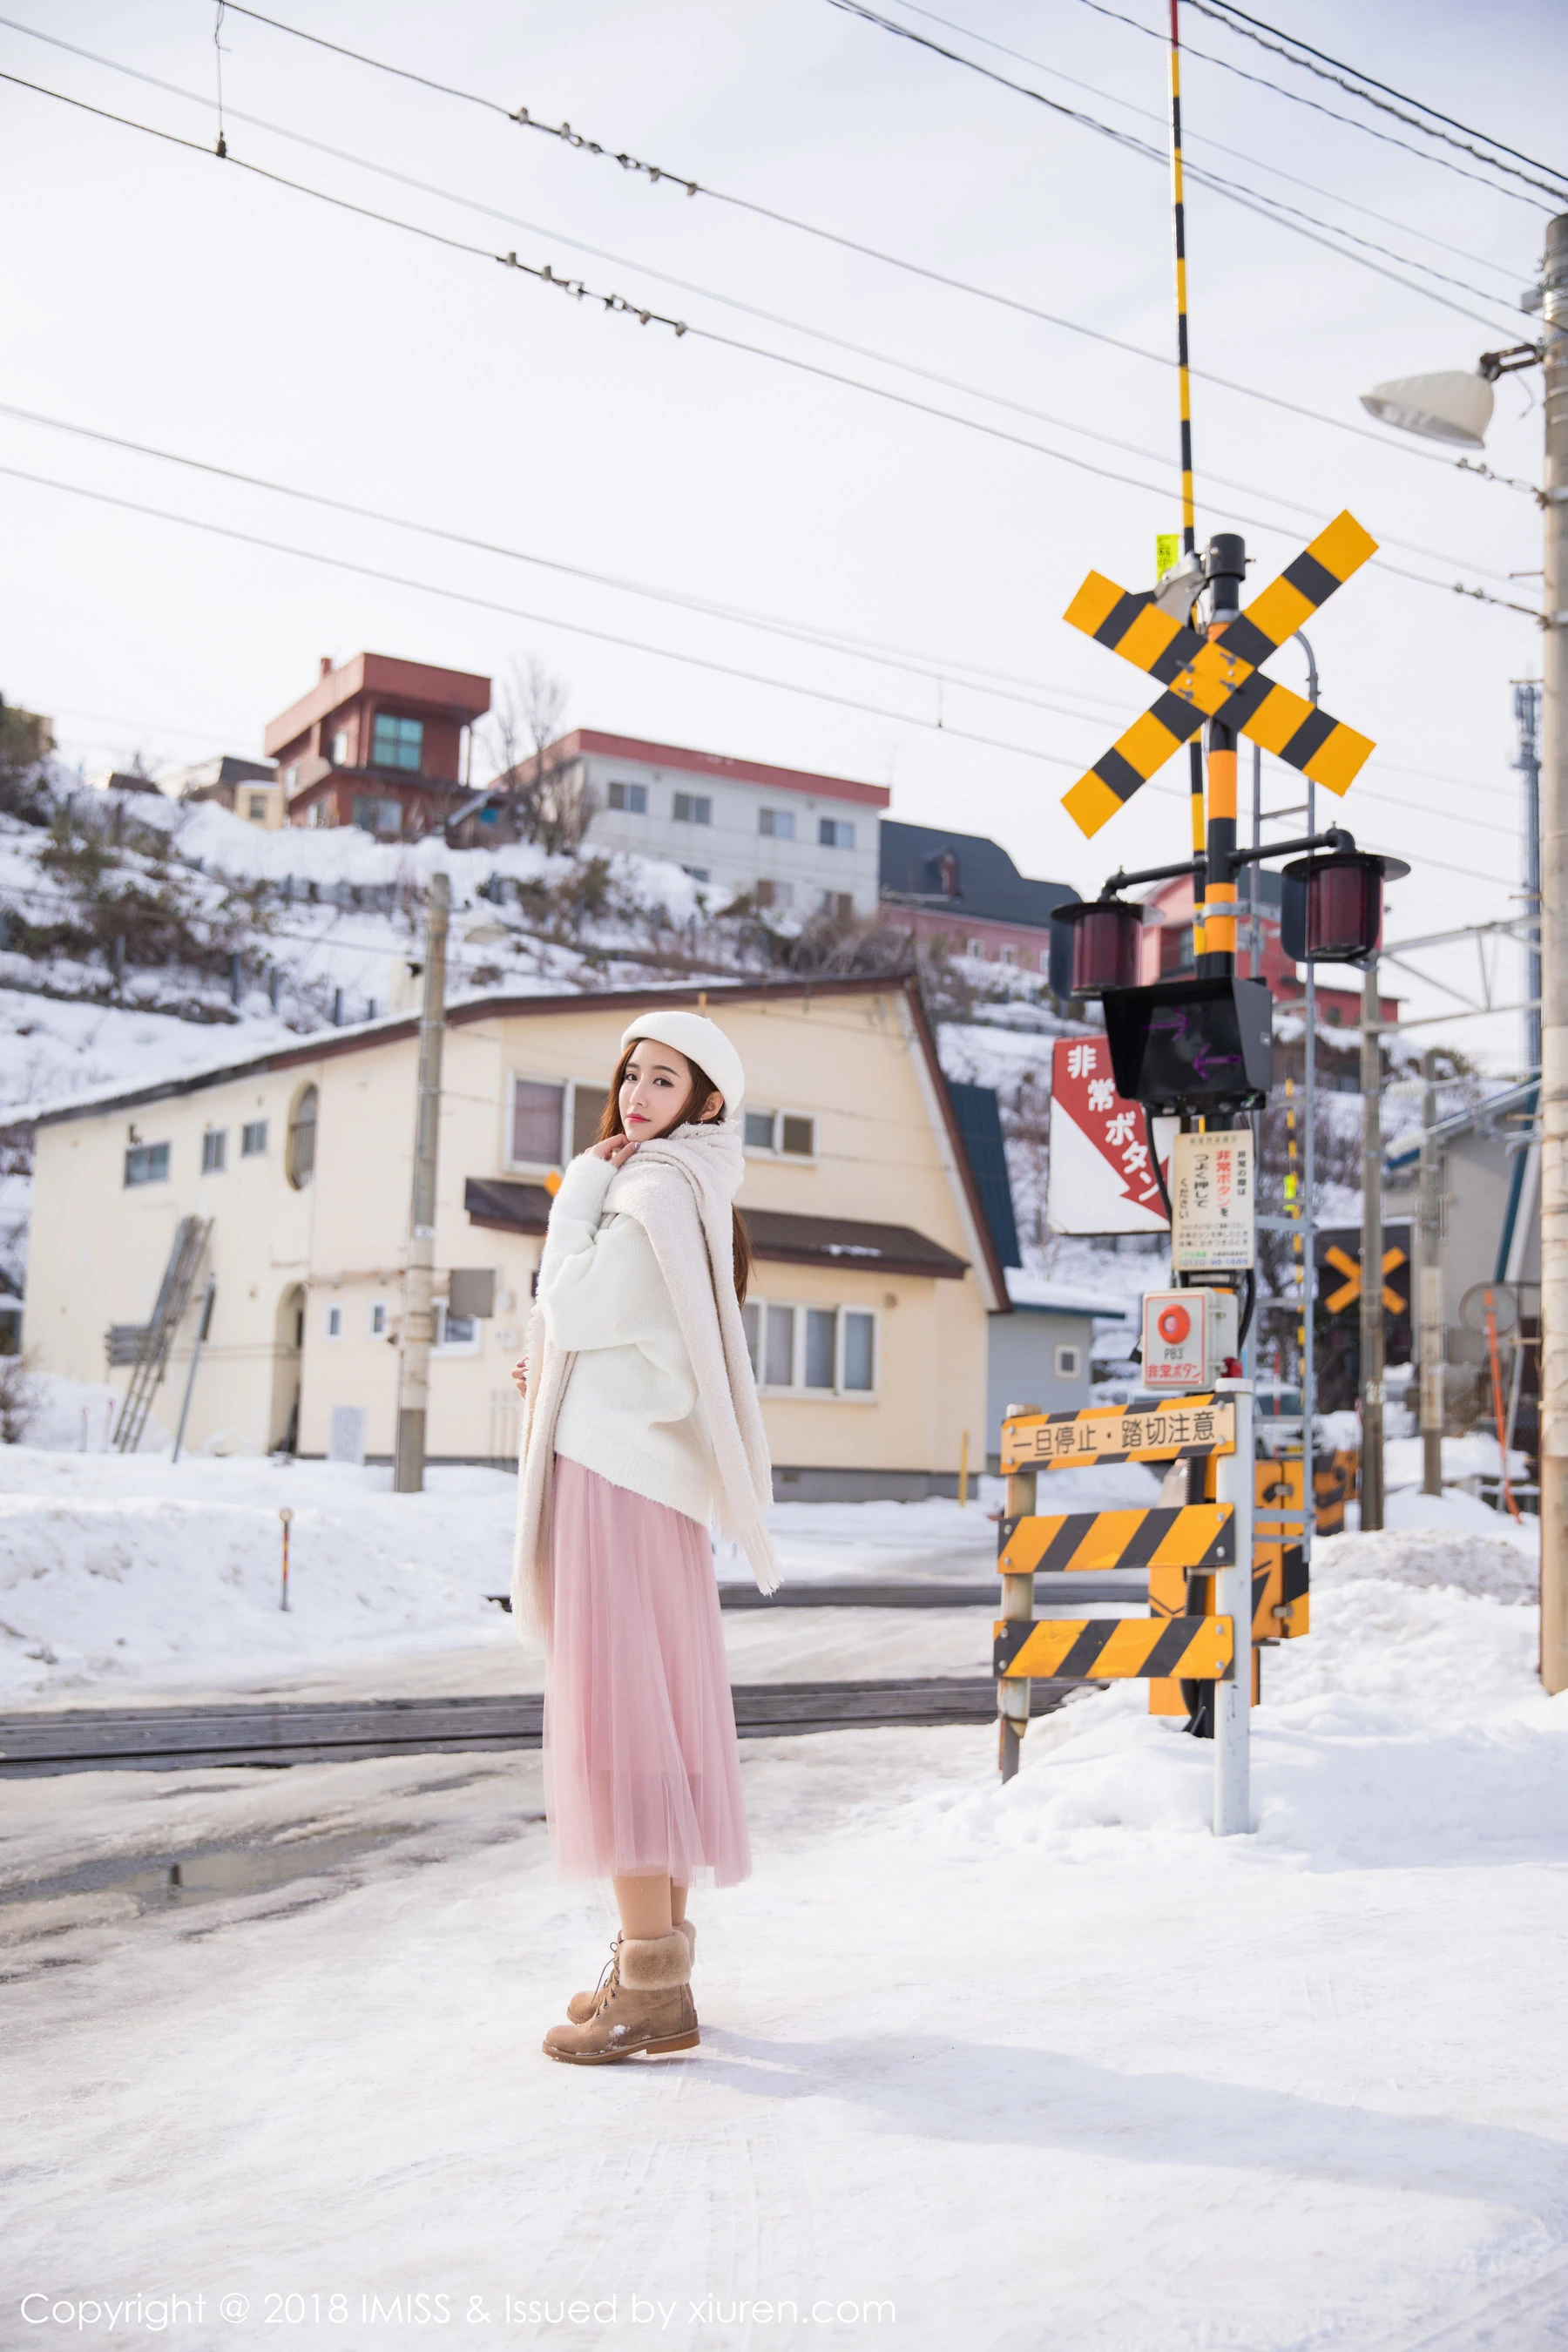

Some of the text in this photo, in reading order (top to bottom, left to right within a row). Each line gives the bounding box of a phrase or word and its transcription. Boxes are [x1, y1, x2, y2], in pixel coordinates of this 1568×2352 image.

[1067, 1044, 1160, 1201] 非常ボタン
[1147, 1362, 1201, 1379] 非常ボタン
[1013, 1410, 1215, 1456] 一旦停止・踏切注意
